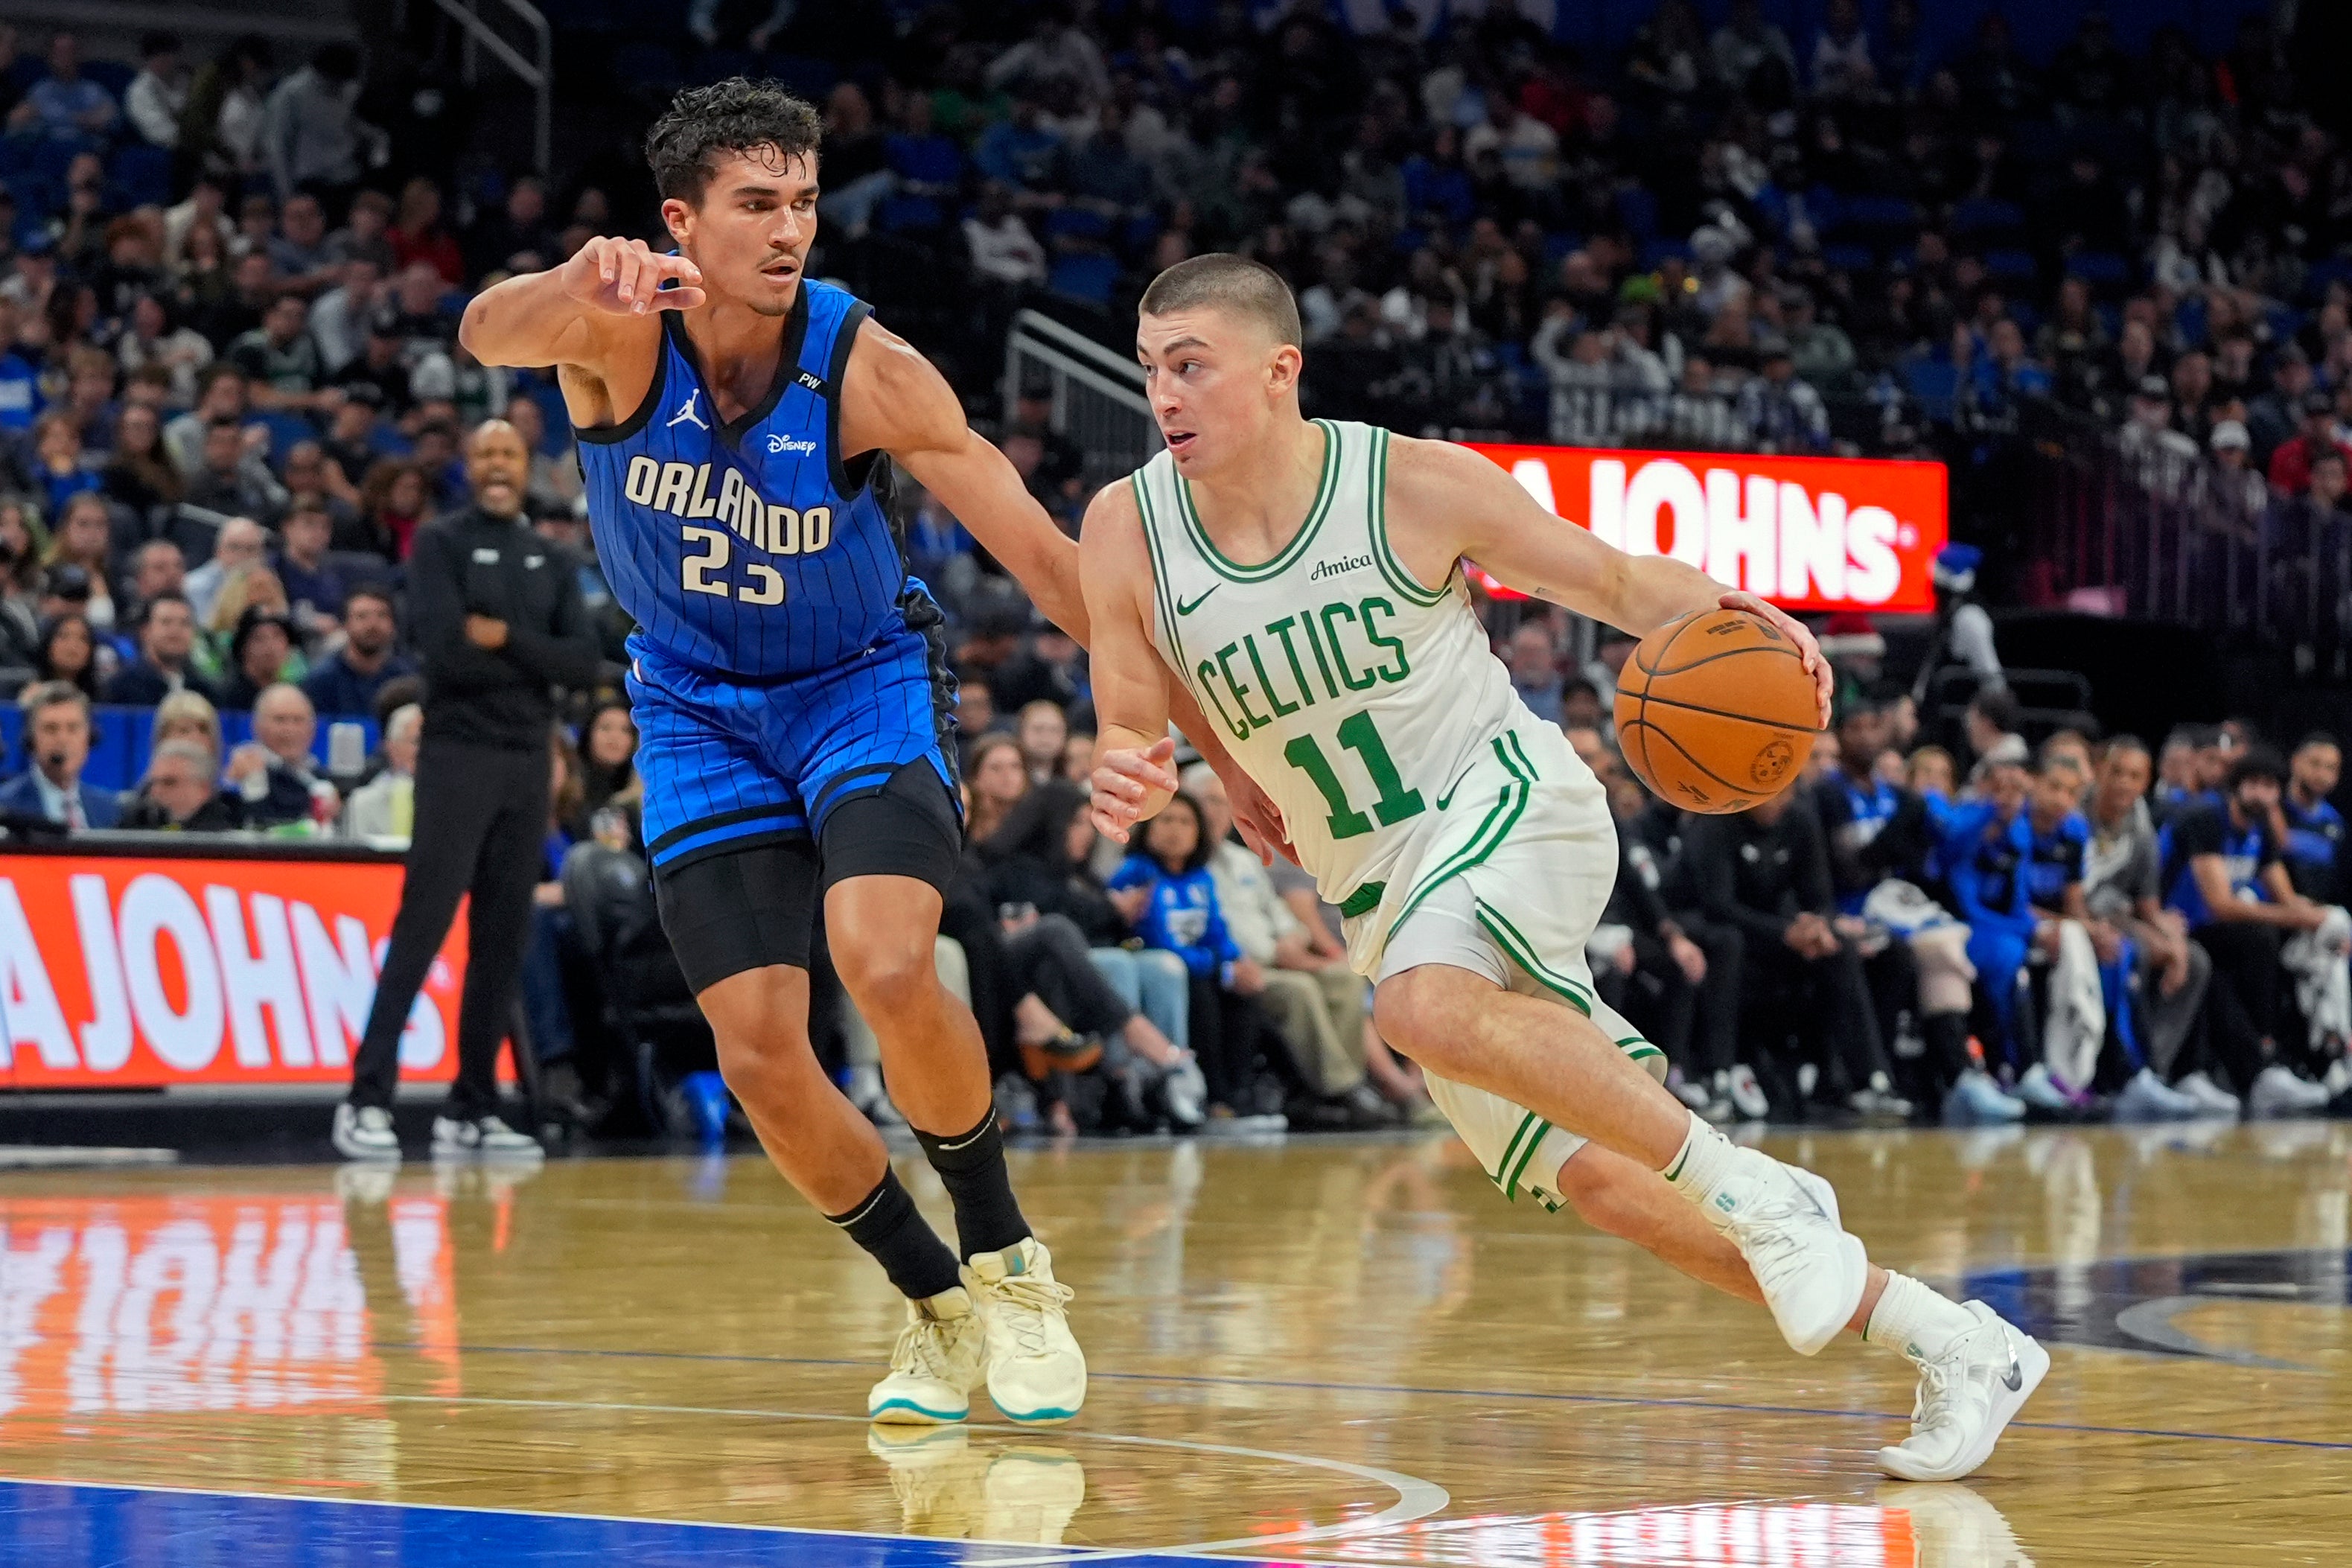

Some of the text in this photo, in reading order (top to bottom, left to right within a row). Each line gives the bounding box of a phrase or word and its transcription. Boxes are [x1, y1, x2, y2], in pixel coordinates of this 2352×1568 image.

[798, 373, 821, 389] PW
[625, 456, 831, 555] ORLANDO
[1310, 553, 1373, 581] Amica
[1196, 596, 1411, 742] CELTICS
[1283, 709, 1427, 840] 11
